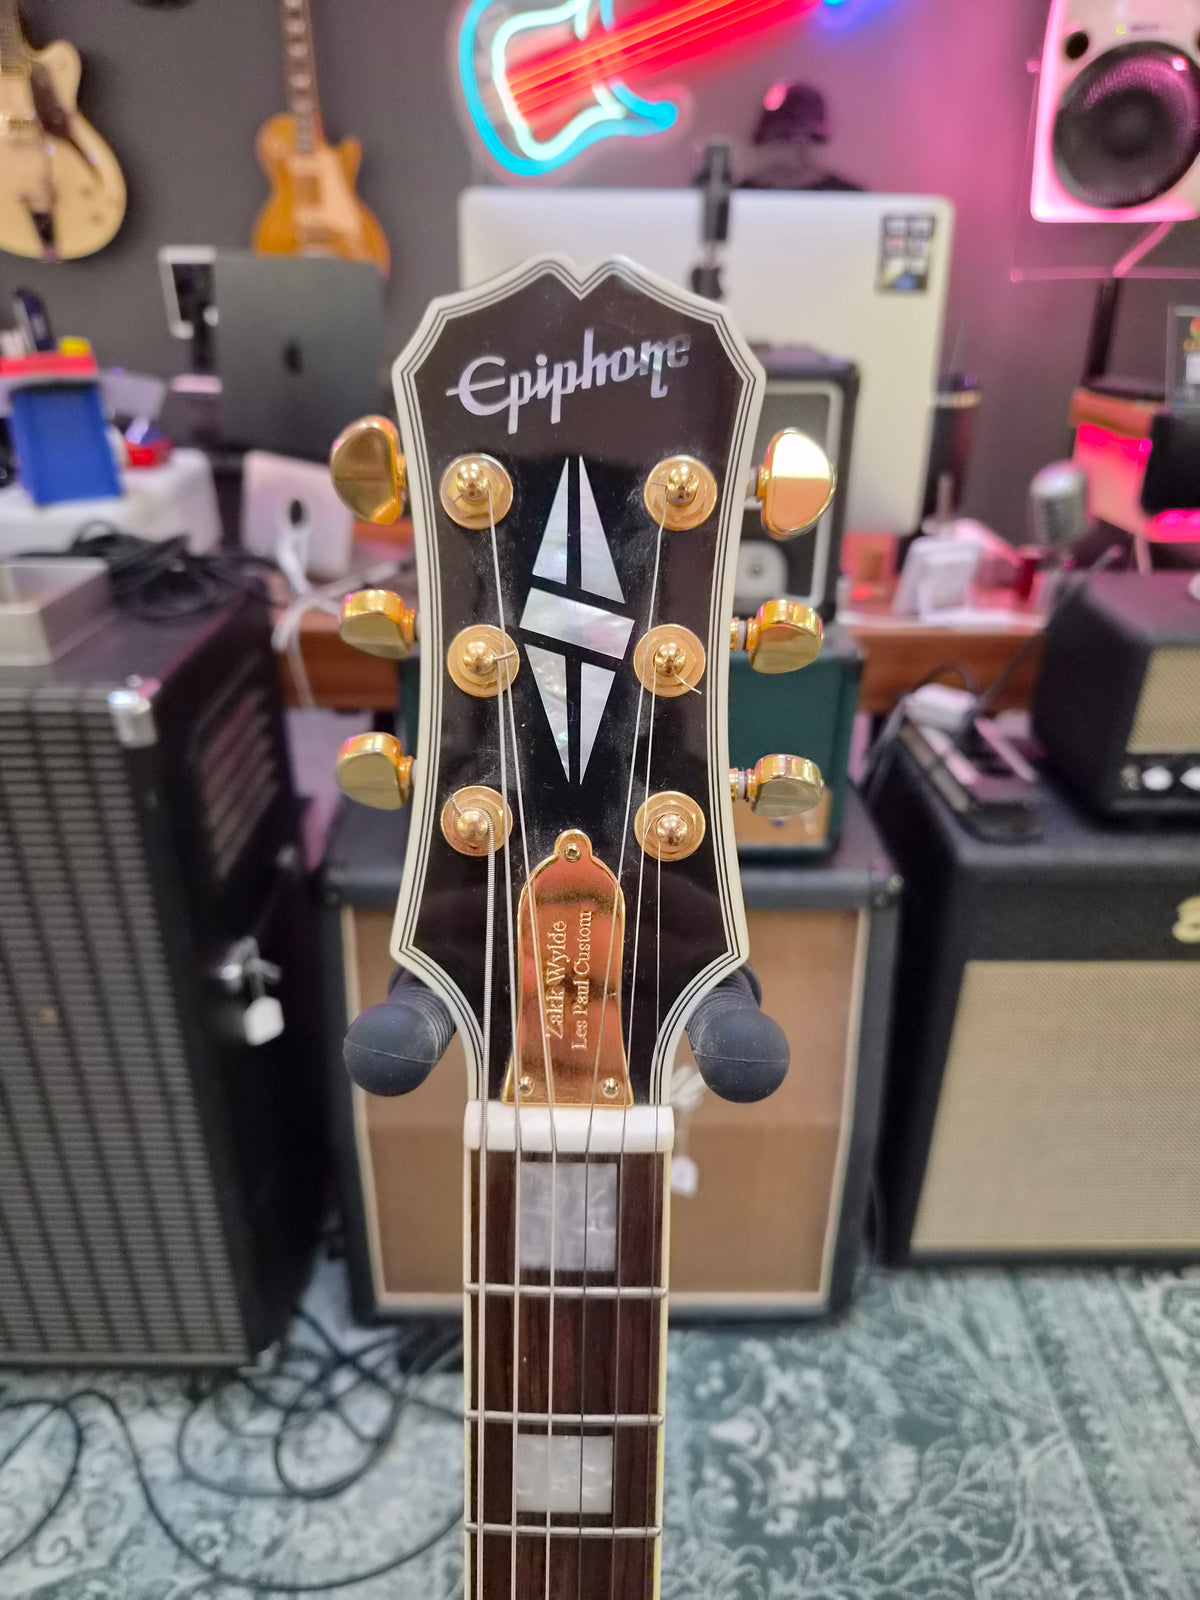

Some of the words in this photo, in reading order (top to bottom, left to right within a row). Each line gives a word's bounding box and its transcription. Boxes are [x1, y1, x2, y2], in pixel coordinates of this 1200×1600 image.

[445, 328, 691, 435] Epiphone
[546, 920, 571, 985] Wylde
[573, 911, 592, 975] Custom
[545, 985, 565, 1040] Zakk
[572, 979, 590, 1015] Paul
[571, 1019, 588, 1050] Les
